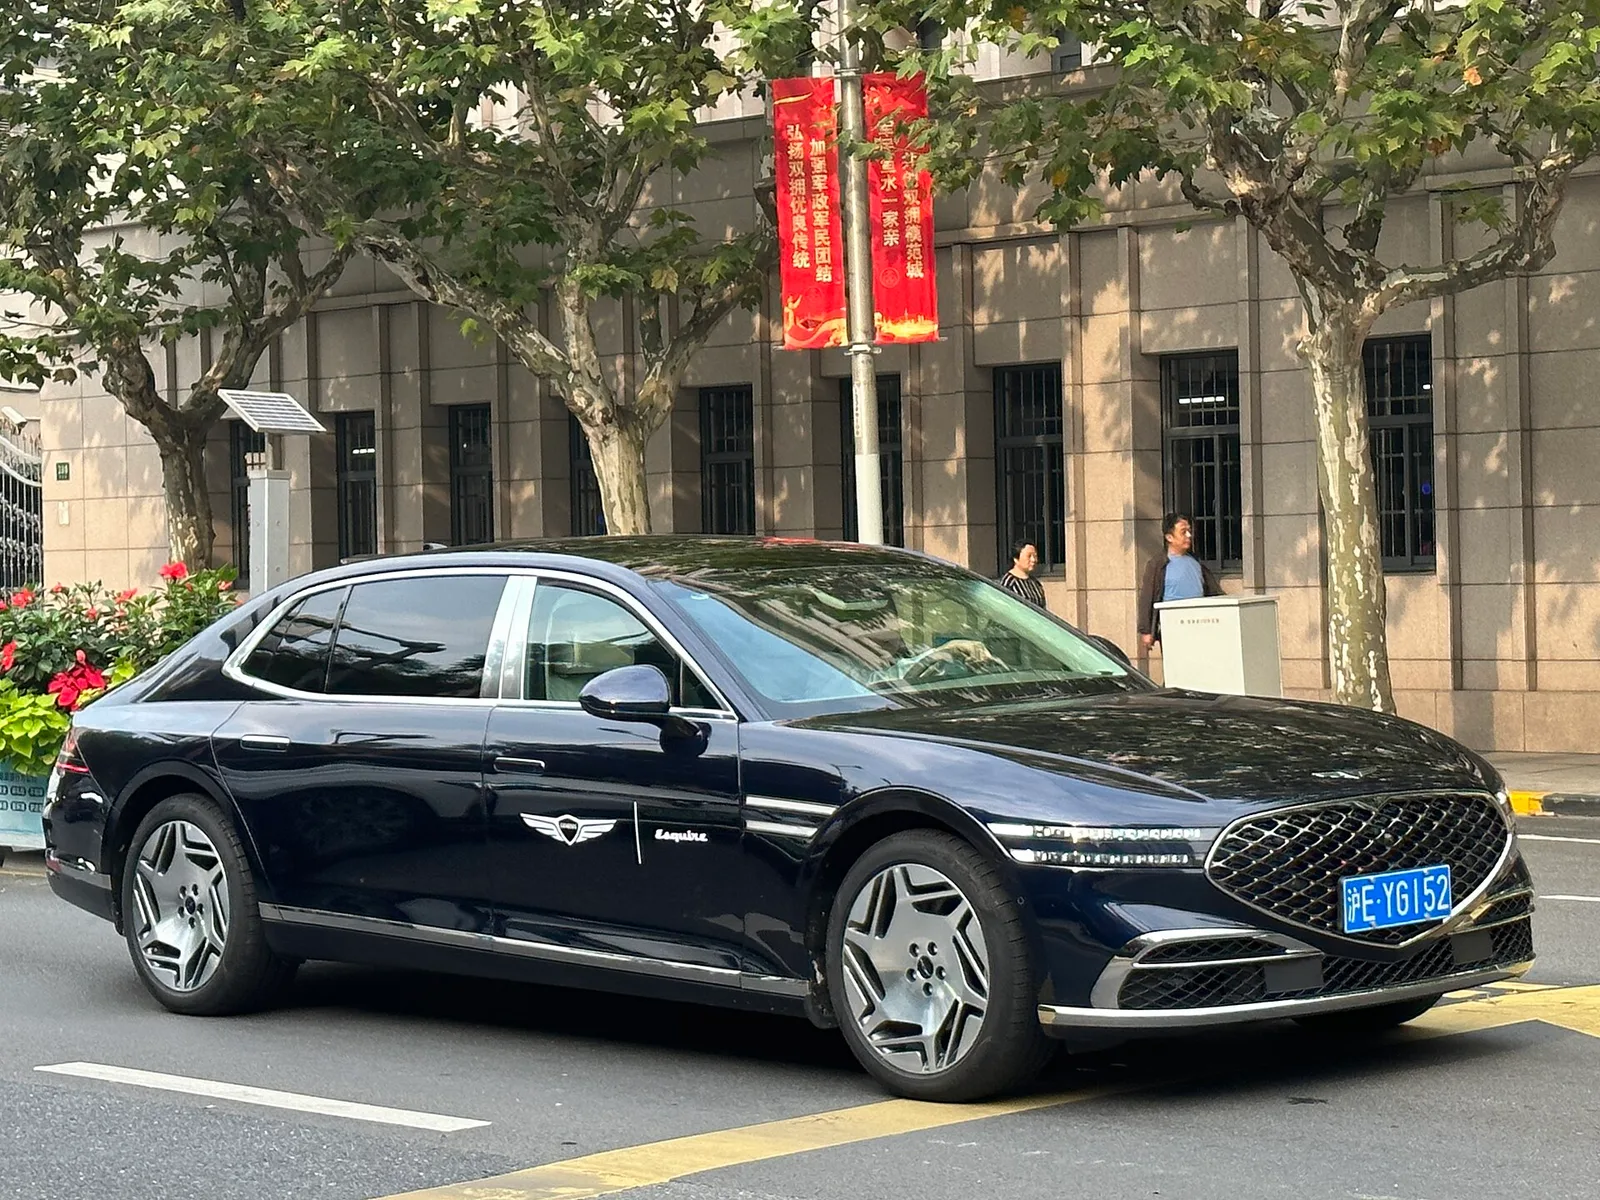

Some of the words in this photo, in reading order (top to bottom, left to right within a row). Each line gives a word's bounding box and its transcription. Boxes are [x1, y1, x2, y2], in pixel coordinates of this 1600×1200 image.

[786, 124, 811, 269] 弘扬双拥优良传统
[809, 138, 833, 283] 加强军政军民团结
[654, 828, 709, 842] Esquire
